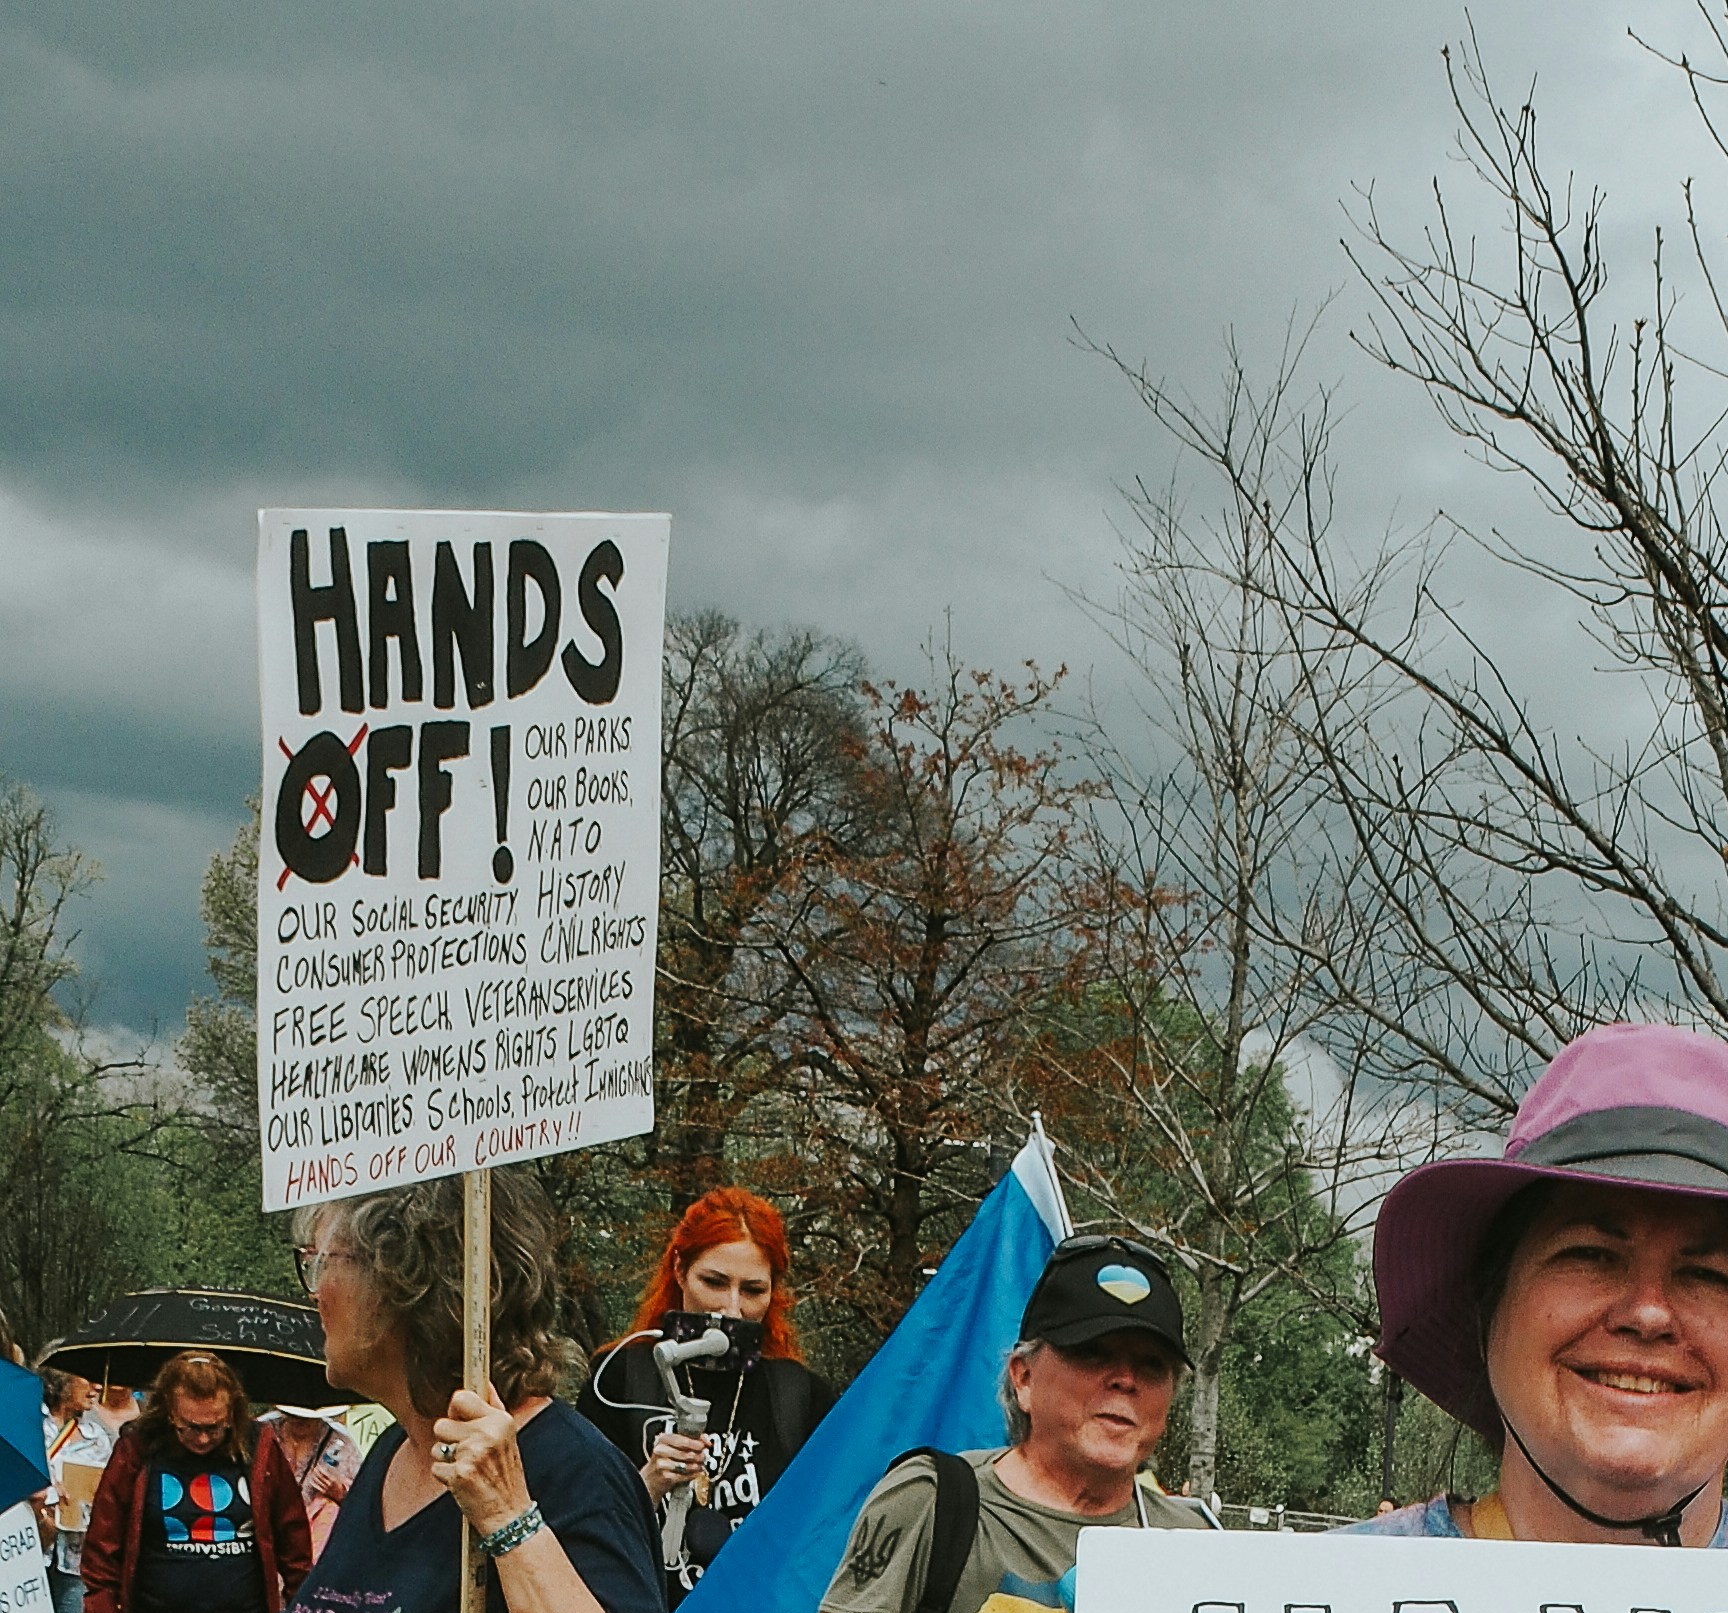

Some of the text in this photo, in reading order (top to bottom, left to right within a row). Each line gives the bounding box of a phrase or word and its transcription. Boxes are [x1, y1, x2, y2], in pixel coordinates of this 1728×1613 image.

[290, 527, 624, 716] HANDS
[525, 724, 567, 759] OUR
[528, 775, 566, 810] OUR
[277, 901, 337, 944] OUR
[277, 944, 386, 993] CONSUMER
[274, 1002, 347, 1055] FREE
[403, 1039, 487, 1085] WOMENS
[569, 1012, 629, 1060] LGBTQ
[268, 1107, 313, 1152] OUR
[285, 1152, 358, 1203] HANDS
[370, 1145, 407, 1180] OFF
[415, 1134, 456, 1174] OUR
[353, 1412, 388, 1445] TA
[0, 1526, 36, 1562] GRAB
[15, 1576, 47, 1608] OFF!
